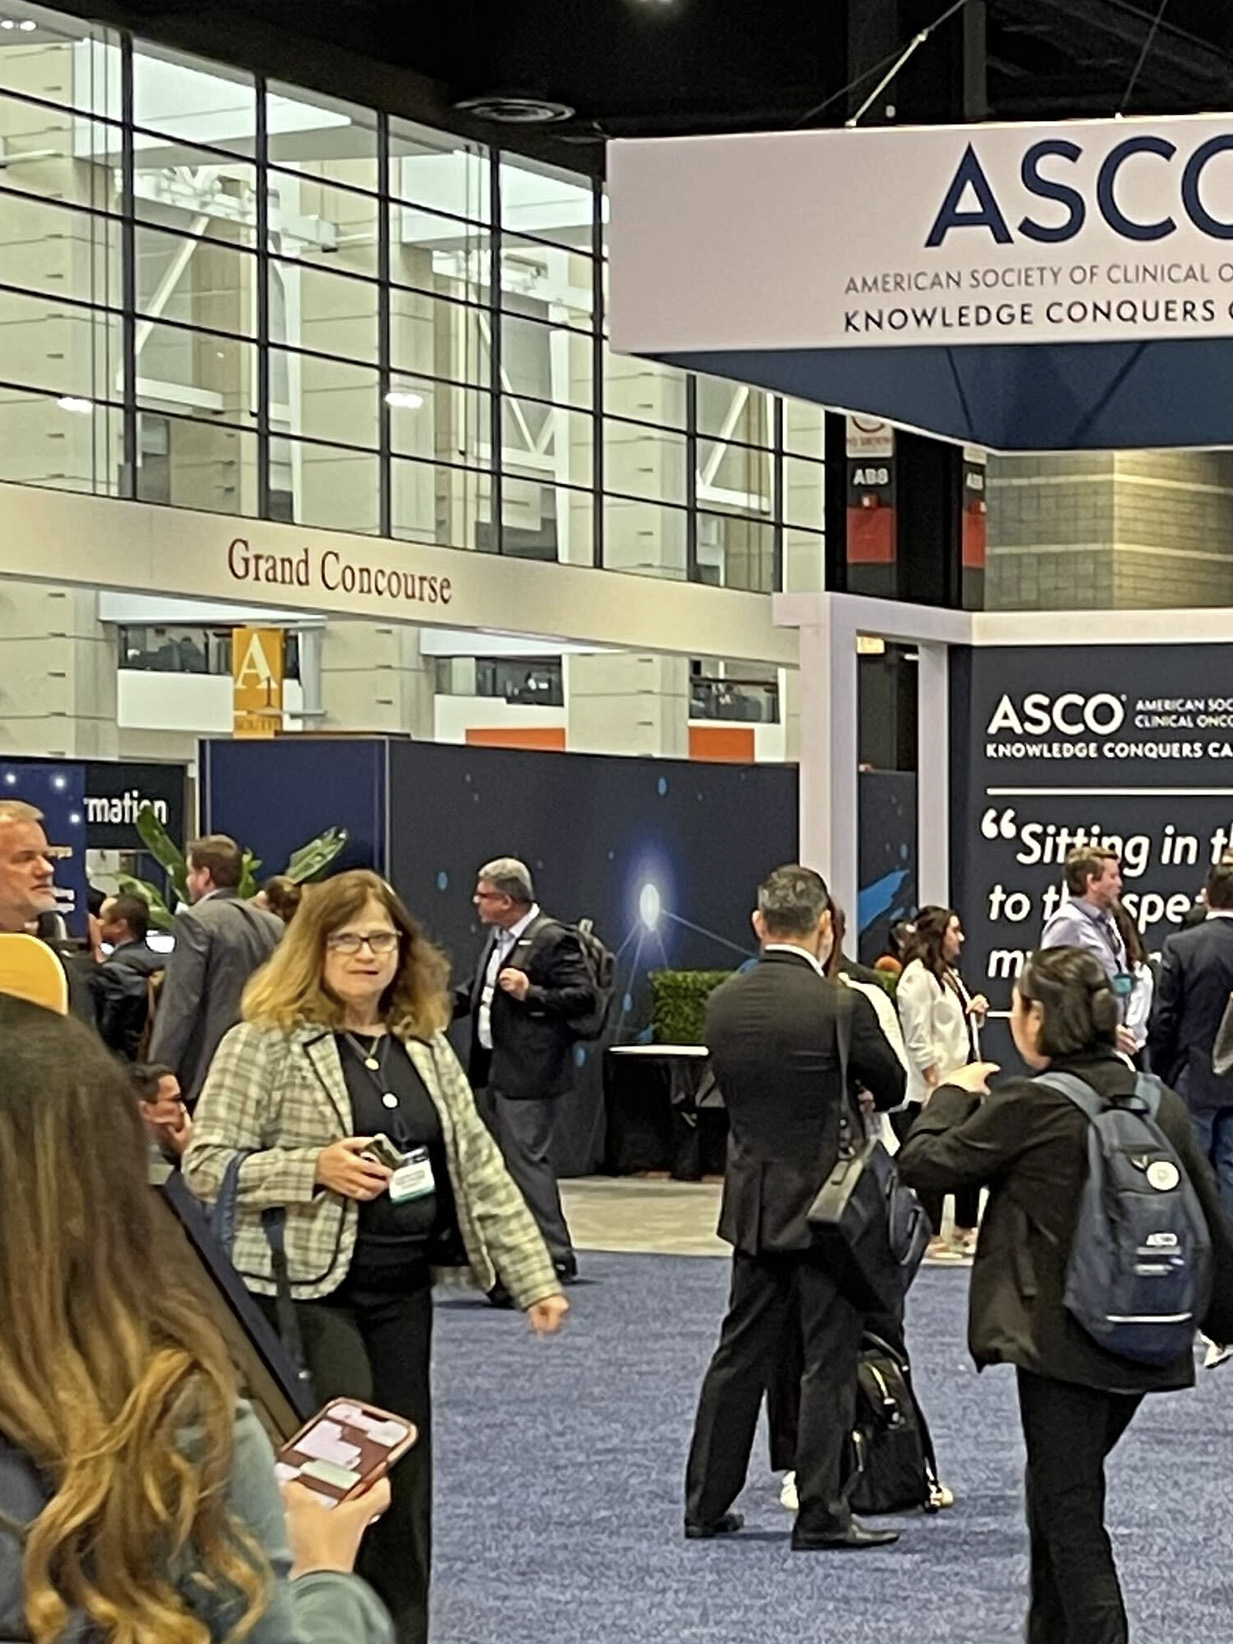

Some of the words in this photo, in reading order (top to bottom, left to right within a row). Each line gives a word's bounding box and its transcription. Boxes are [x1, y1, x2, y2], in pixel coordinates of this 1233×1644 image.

[845, 270, 962, 294] AMERICAN
[970, 266, 1062, 289] SOCIETY
[1069, 264, 1100, 286] OF
[1107, 262, 1208, 285] CLINICAL
[845, 302, 1034, 332] KNOWLEDGE
[1046, 299, 1215, 324] CONQUERS
[228, 538, 310, 586] Grand
[321, 551, 452, 604] Concourse
[987, 693, 1126, 735] ASCO
[1135, 699, 1204, 712] AMERICAN
[1135, 715, 1193, 728] CLINICAL
[986, 743, 1098, 758] KNOWLEDGE
[1103, 742, 1203, 759] CONQUERS
[1161, 825, 1198, 865] in
[988, 885, 1030, 921] to
